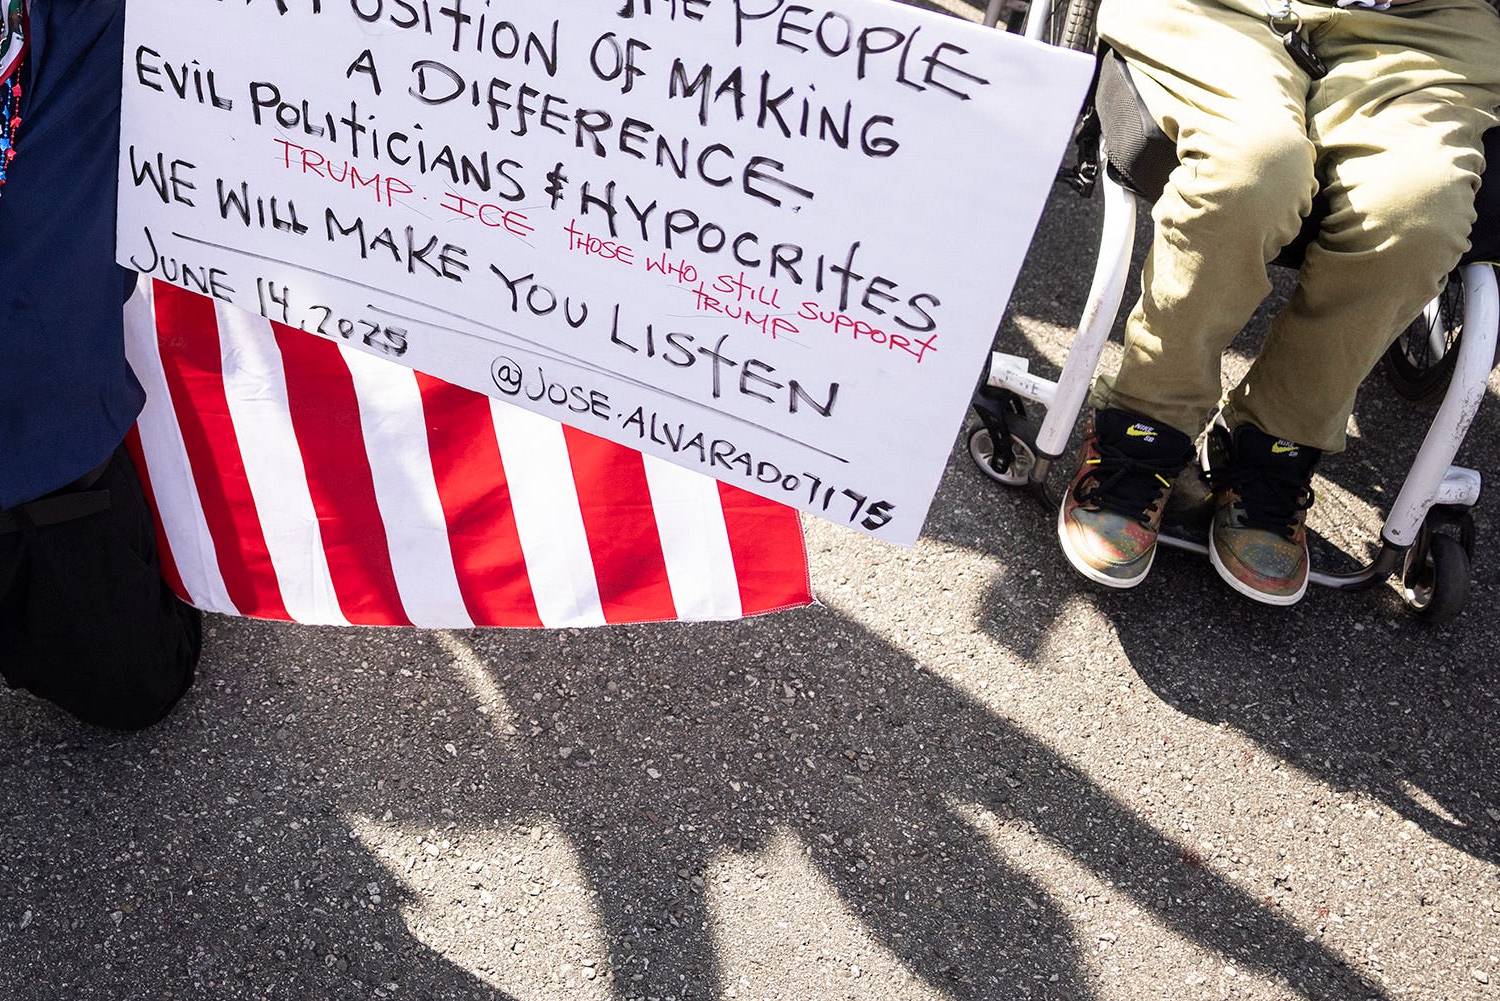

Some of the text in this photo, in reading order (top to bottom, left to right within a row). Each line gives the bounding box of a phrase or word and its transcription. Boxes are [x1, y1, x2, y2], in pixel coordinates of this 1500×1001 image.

[346, 48, 382, 96] A
[589, 31, 652, 95] OF
[129, 145, 197, 208] WE
[216, 177, 309, 236] WILL
[325, 206, 471, 283] MAKE
[489, 262, 588, 329] YOU
[439, 191, 536, 238] ICE
[130, 226, 236, 304] JUNE
[1134, 422, 1155, 433] NIKE
